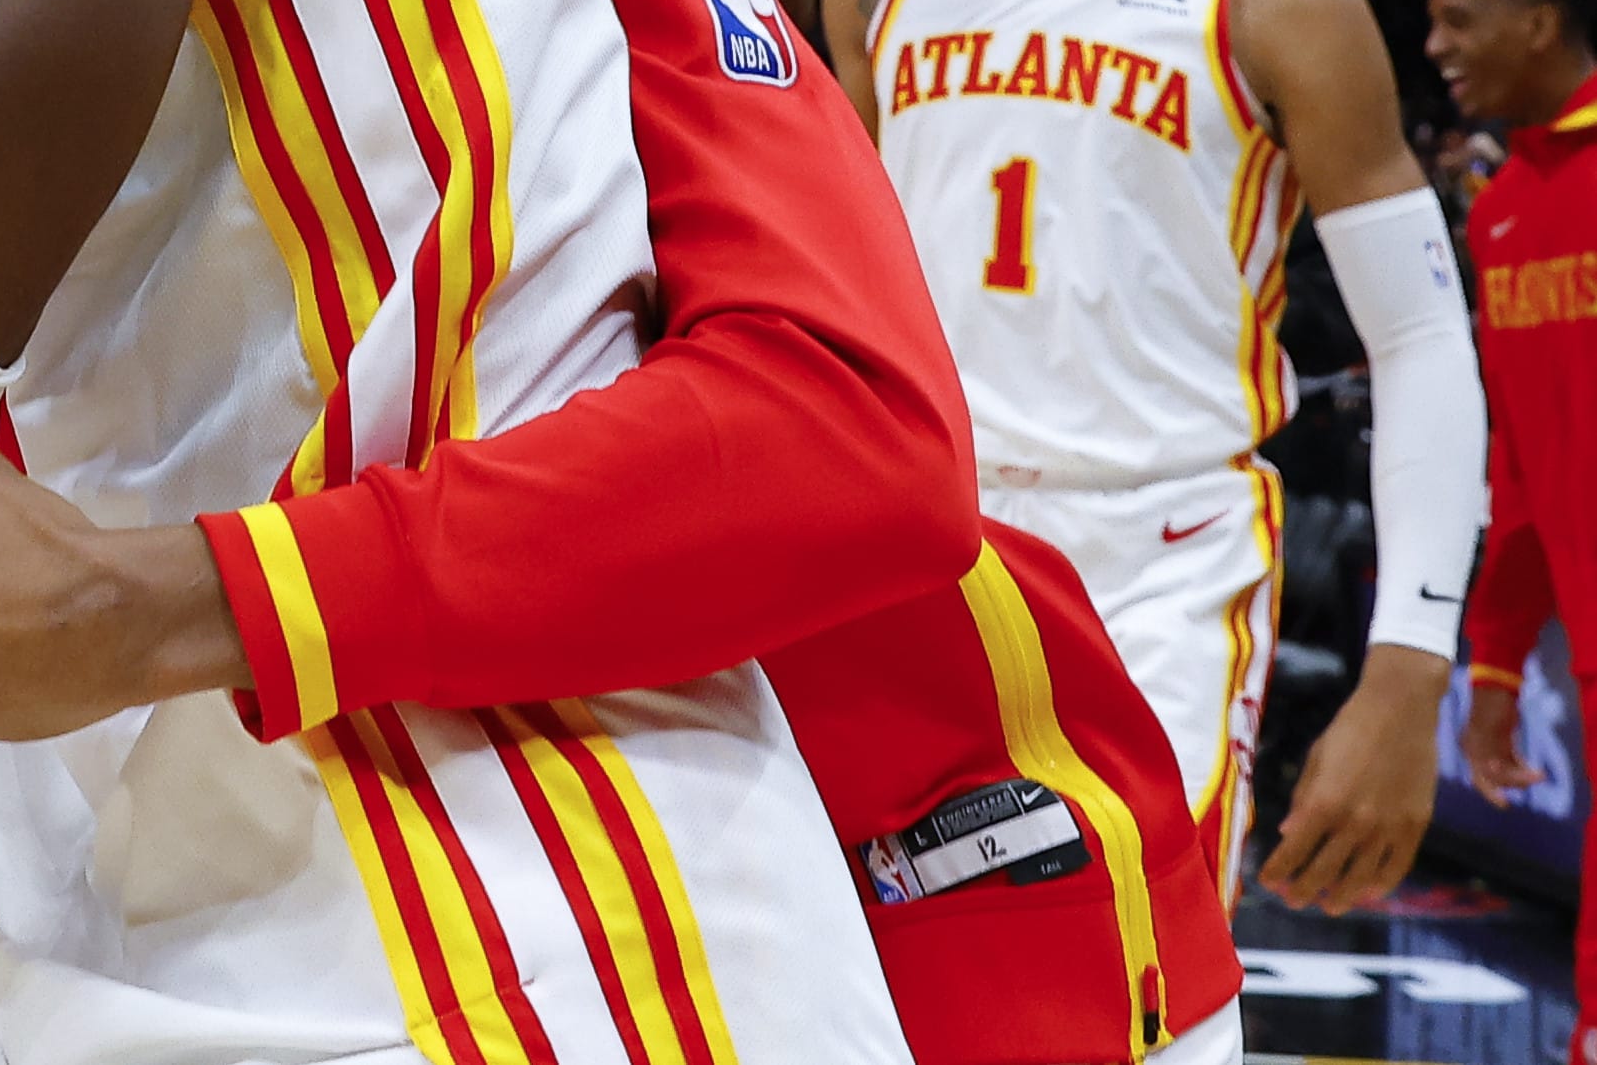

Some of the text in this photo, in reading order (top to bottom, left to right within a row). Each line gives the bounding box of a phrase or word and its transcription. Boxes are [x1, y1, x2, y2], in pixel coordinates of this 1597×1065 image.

[729, 32, 771, 73] NBA
[891, 31, 1192, 152] ATLANTA
[983, 156, 1038, 296] 1
